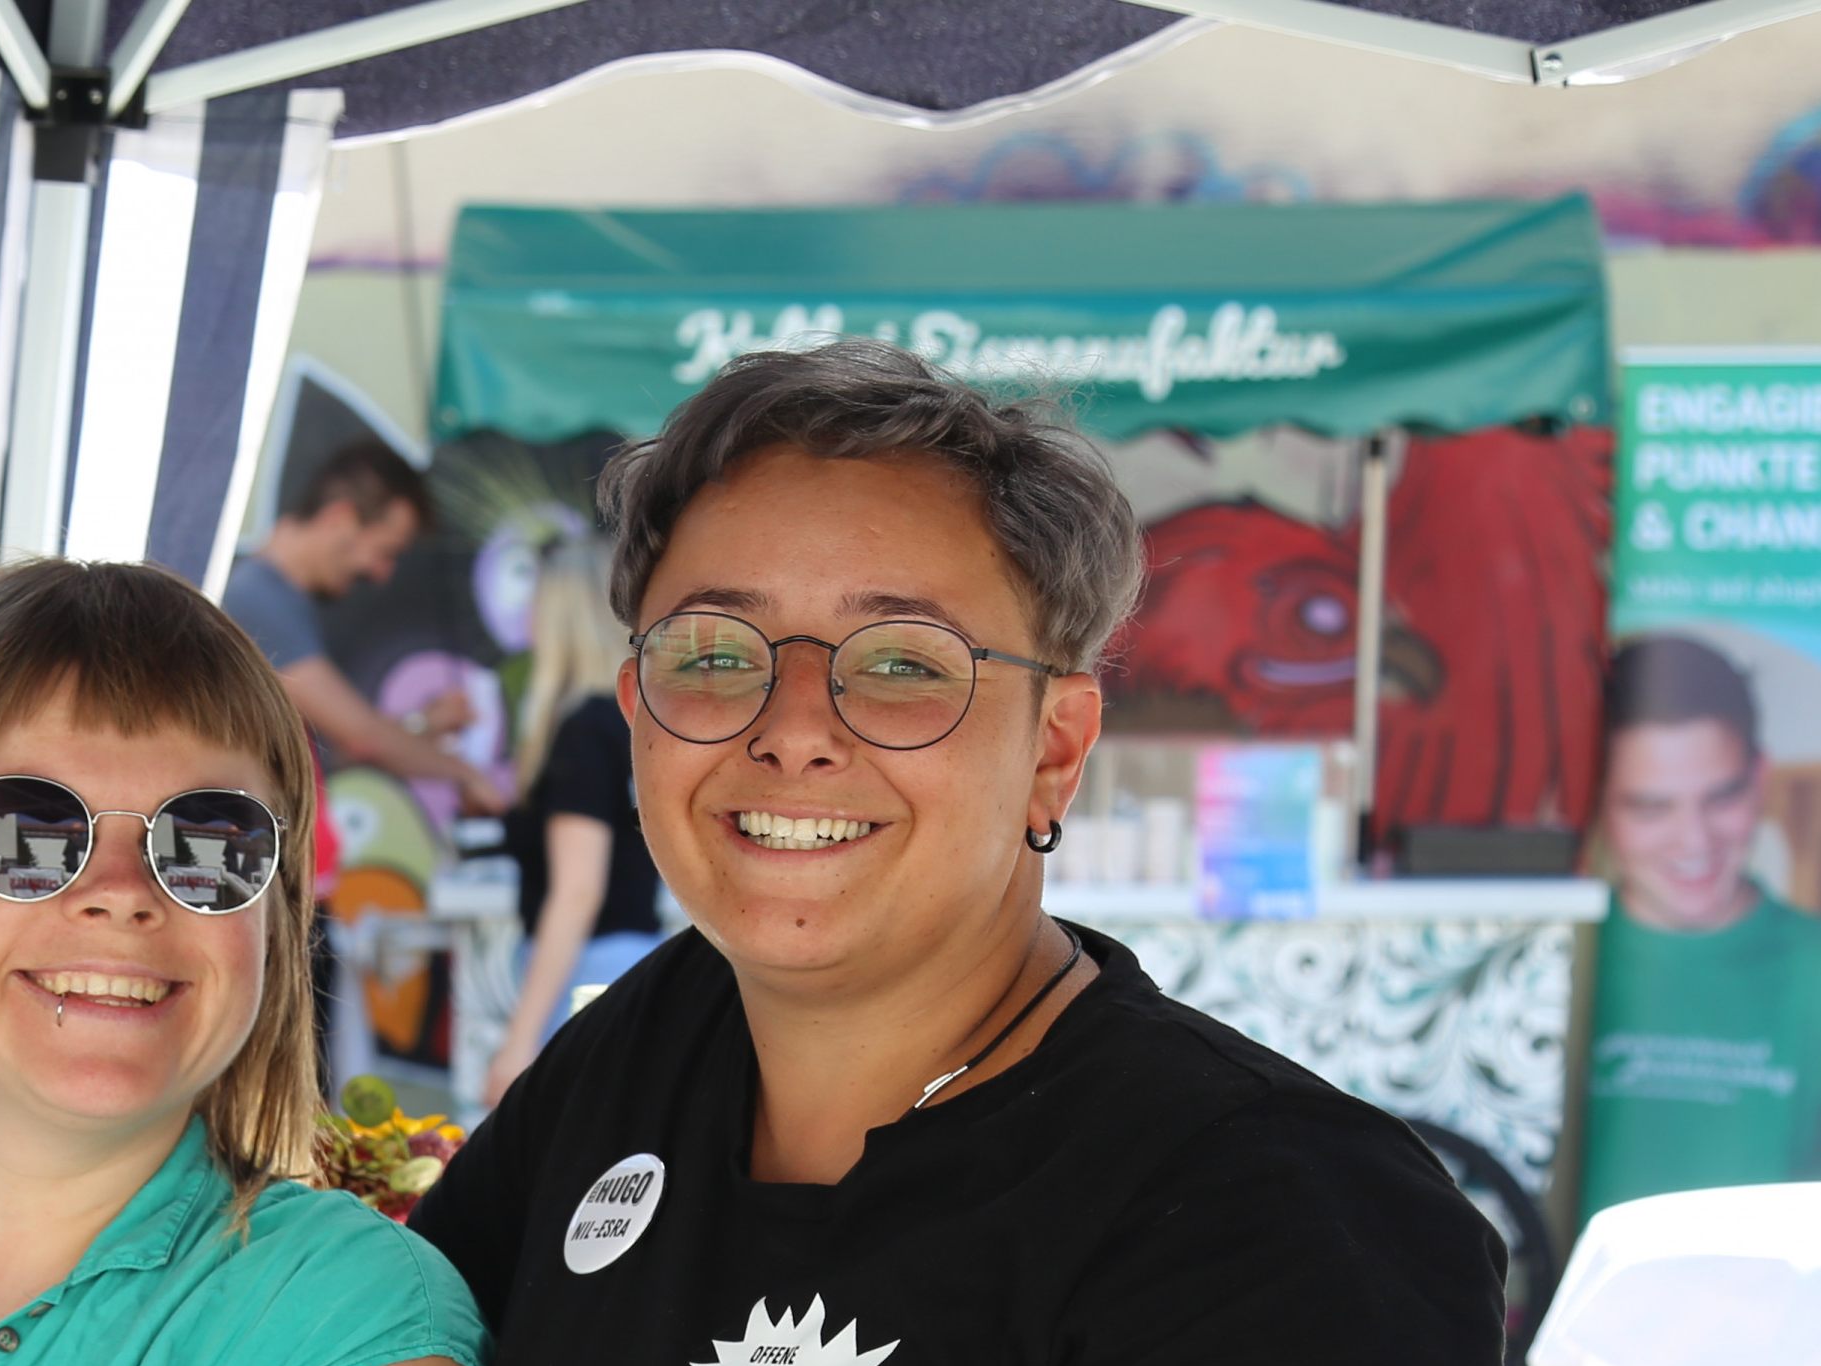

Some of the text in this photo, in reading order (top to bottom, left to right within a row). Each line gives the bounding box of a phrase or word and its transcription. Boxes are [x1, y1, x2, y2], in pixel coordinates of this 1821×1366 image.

[1633, 440, 1820, 493] PUNKTE
[595, 1170, 655, 1206] HUGO
[571, 1218, 632, 1242] NIL-ESRA
[749, 1345, 801, 1366] OFFENE
